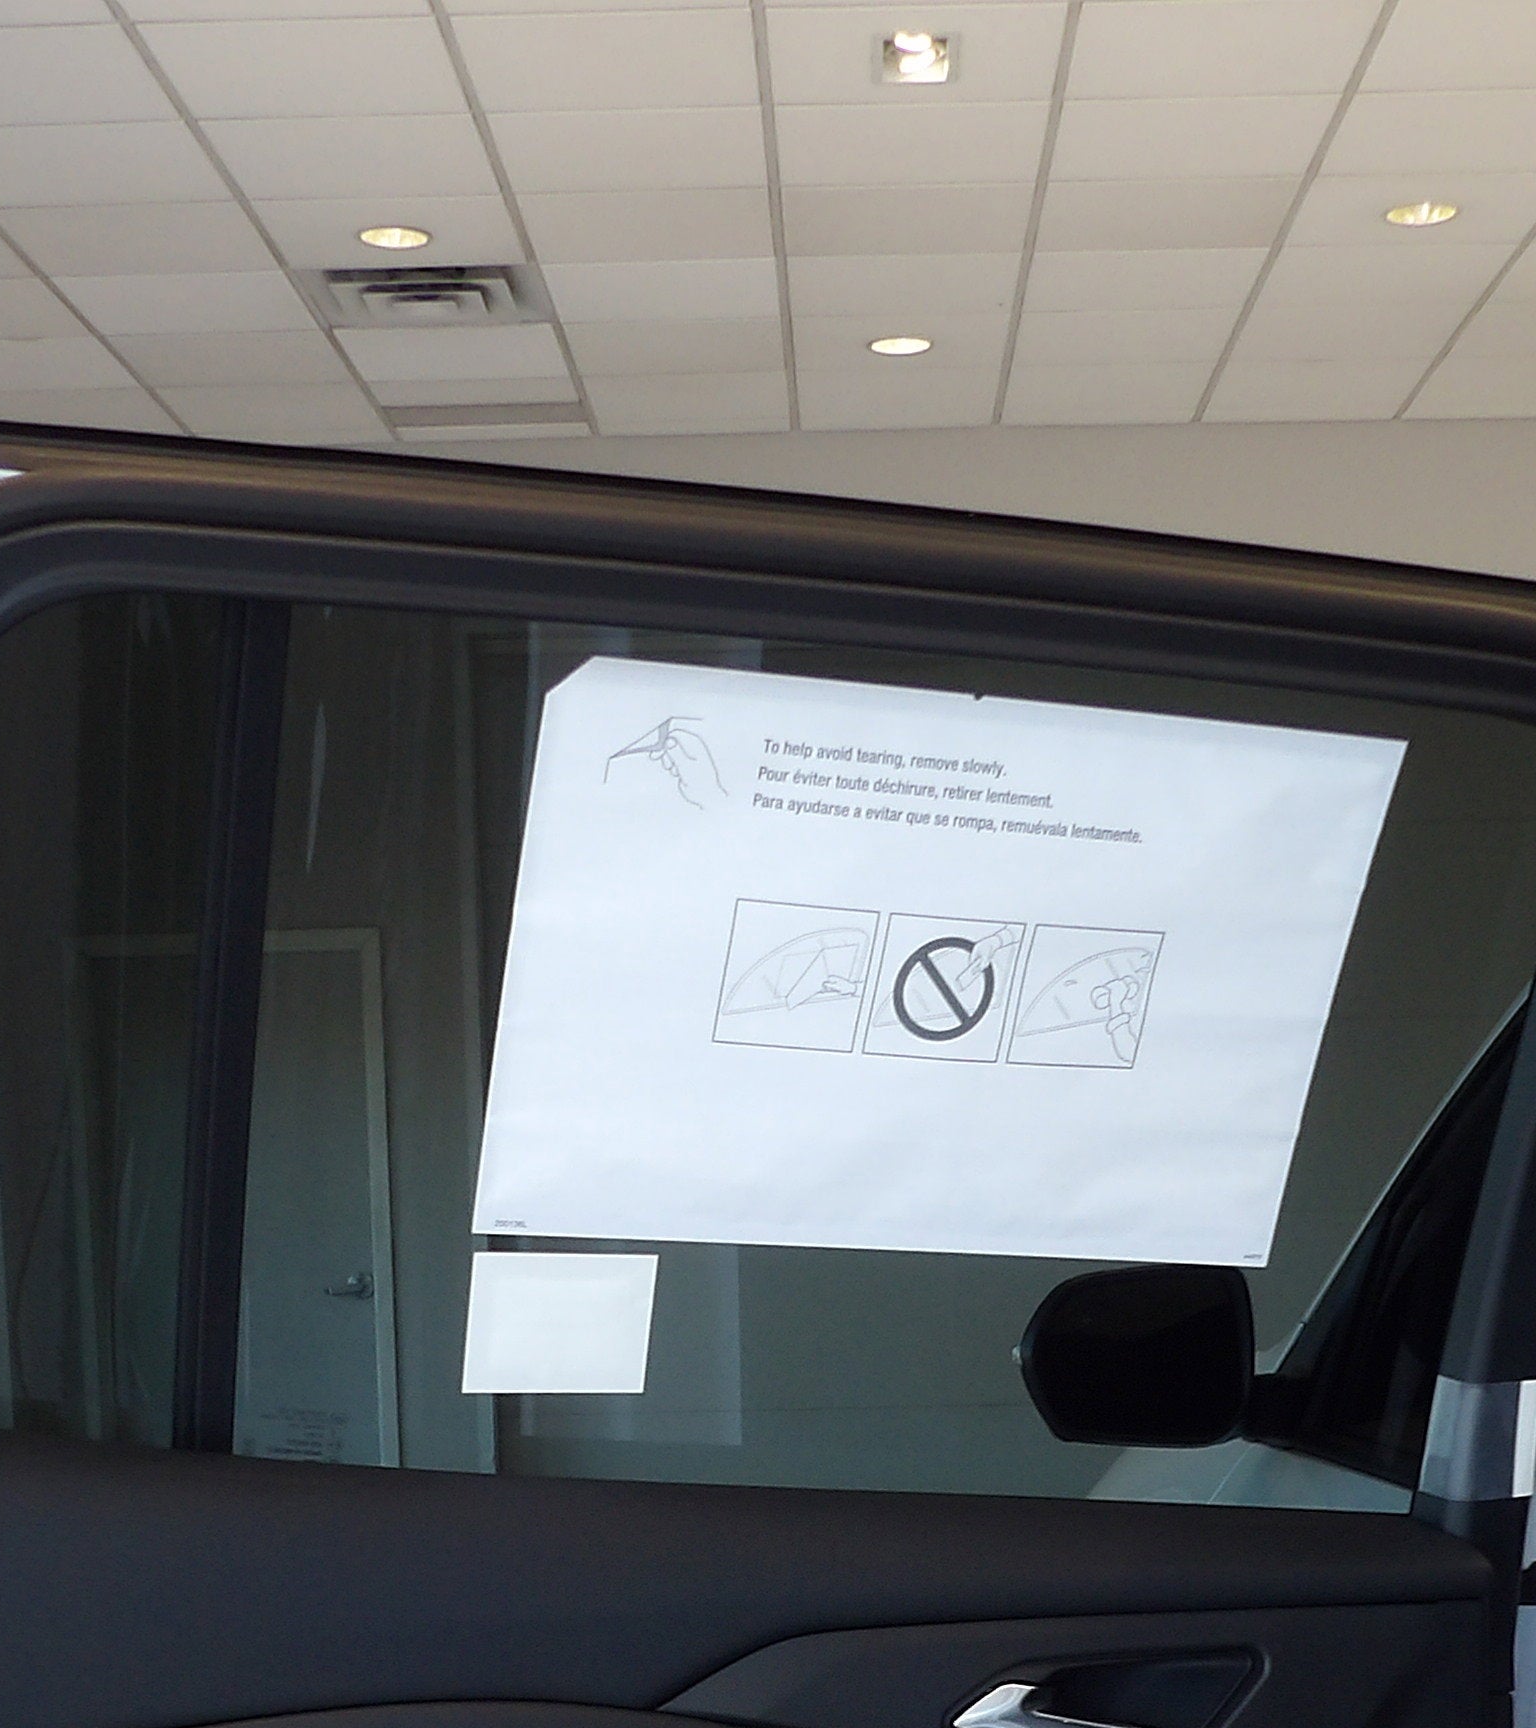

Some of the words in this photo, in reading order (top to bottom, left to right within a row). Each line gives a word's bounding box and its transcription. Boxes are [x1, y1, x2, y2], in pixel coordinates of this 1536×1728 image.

[764, 739, 779, 754] To
[783, 742, 813, 759] help
[817, 746, 853, 762] avoid
[856, 749, 906, 769] tearing,
[910, 756, 958, 772] remove
[962, 758, 1007, 779] slowly.
[758, 766, 789, 782] Pour
[793, 769, 832, 787] éviter
[835, 776, 869, 792] toute
[873, 778, 939, 800] déchirure,
[942, 786, 983, 801] retirer
[985, 788, 1053, 809] lentement.
[752, 793, 783, 809] Para
[787, 800, 849, 817] ayudarse
[853, 806, 862, 818] a
[865, 805, 903, 822] evitar
[906, 811, 931, 826] que
[934, 814, 949, 827] se
[952, 815, 997, 834] rompa,
[1001, 819, 1067, 838] remuévala
[1071, 823, 1143, 844] lentamente.
